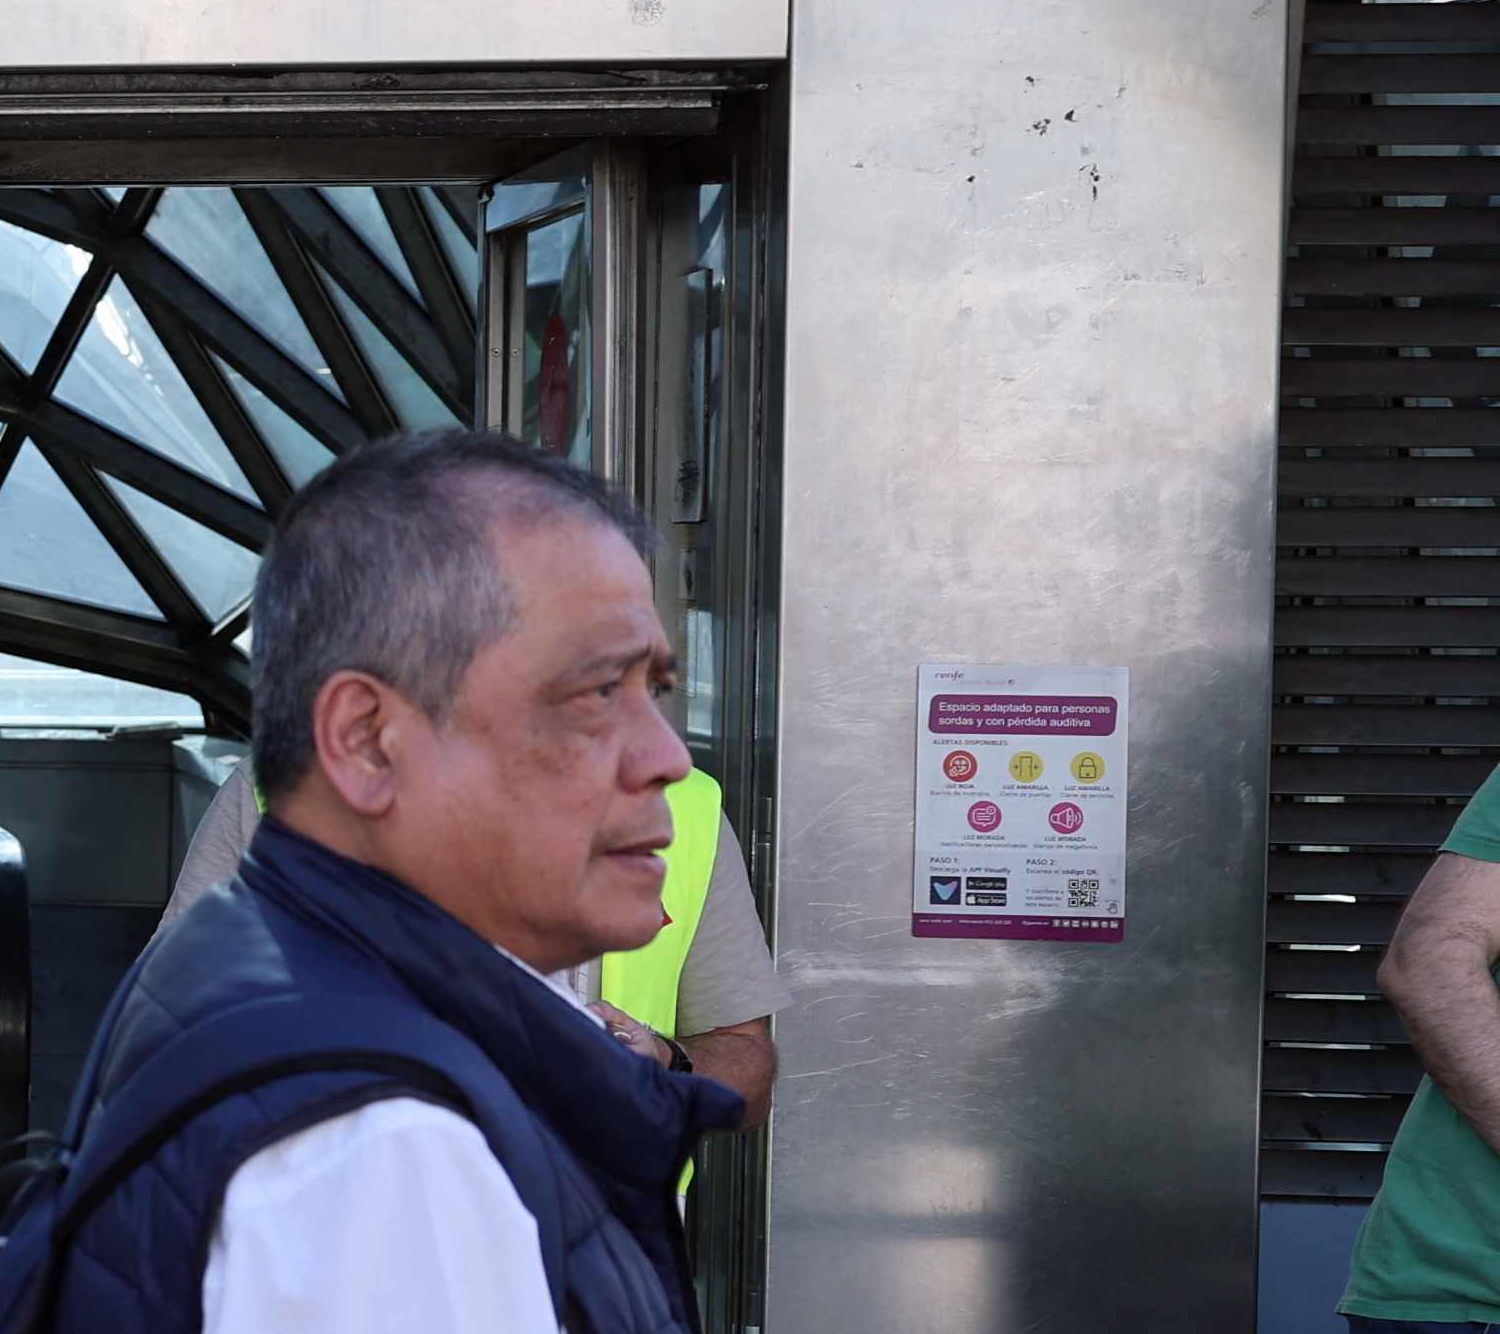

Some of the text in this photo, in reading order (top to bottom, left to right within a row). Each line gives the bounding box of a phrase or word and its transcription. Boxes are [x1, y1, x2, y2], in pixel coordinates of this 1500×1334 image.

[939, 702, 1111, 717] Espacio adaptado para personas
[938, 716, 1091, 728] sordas y con pérdida auditiva
